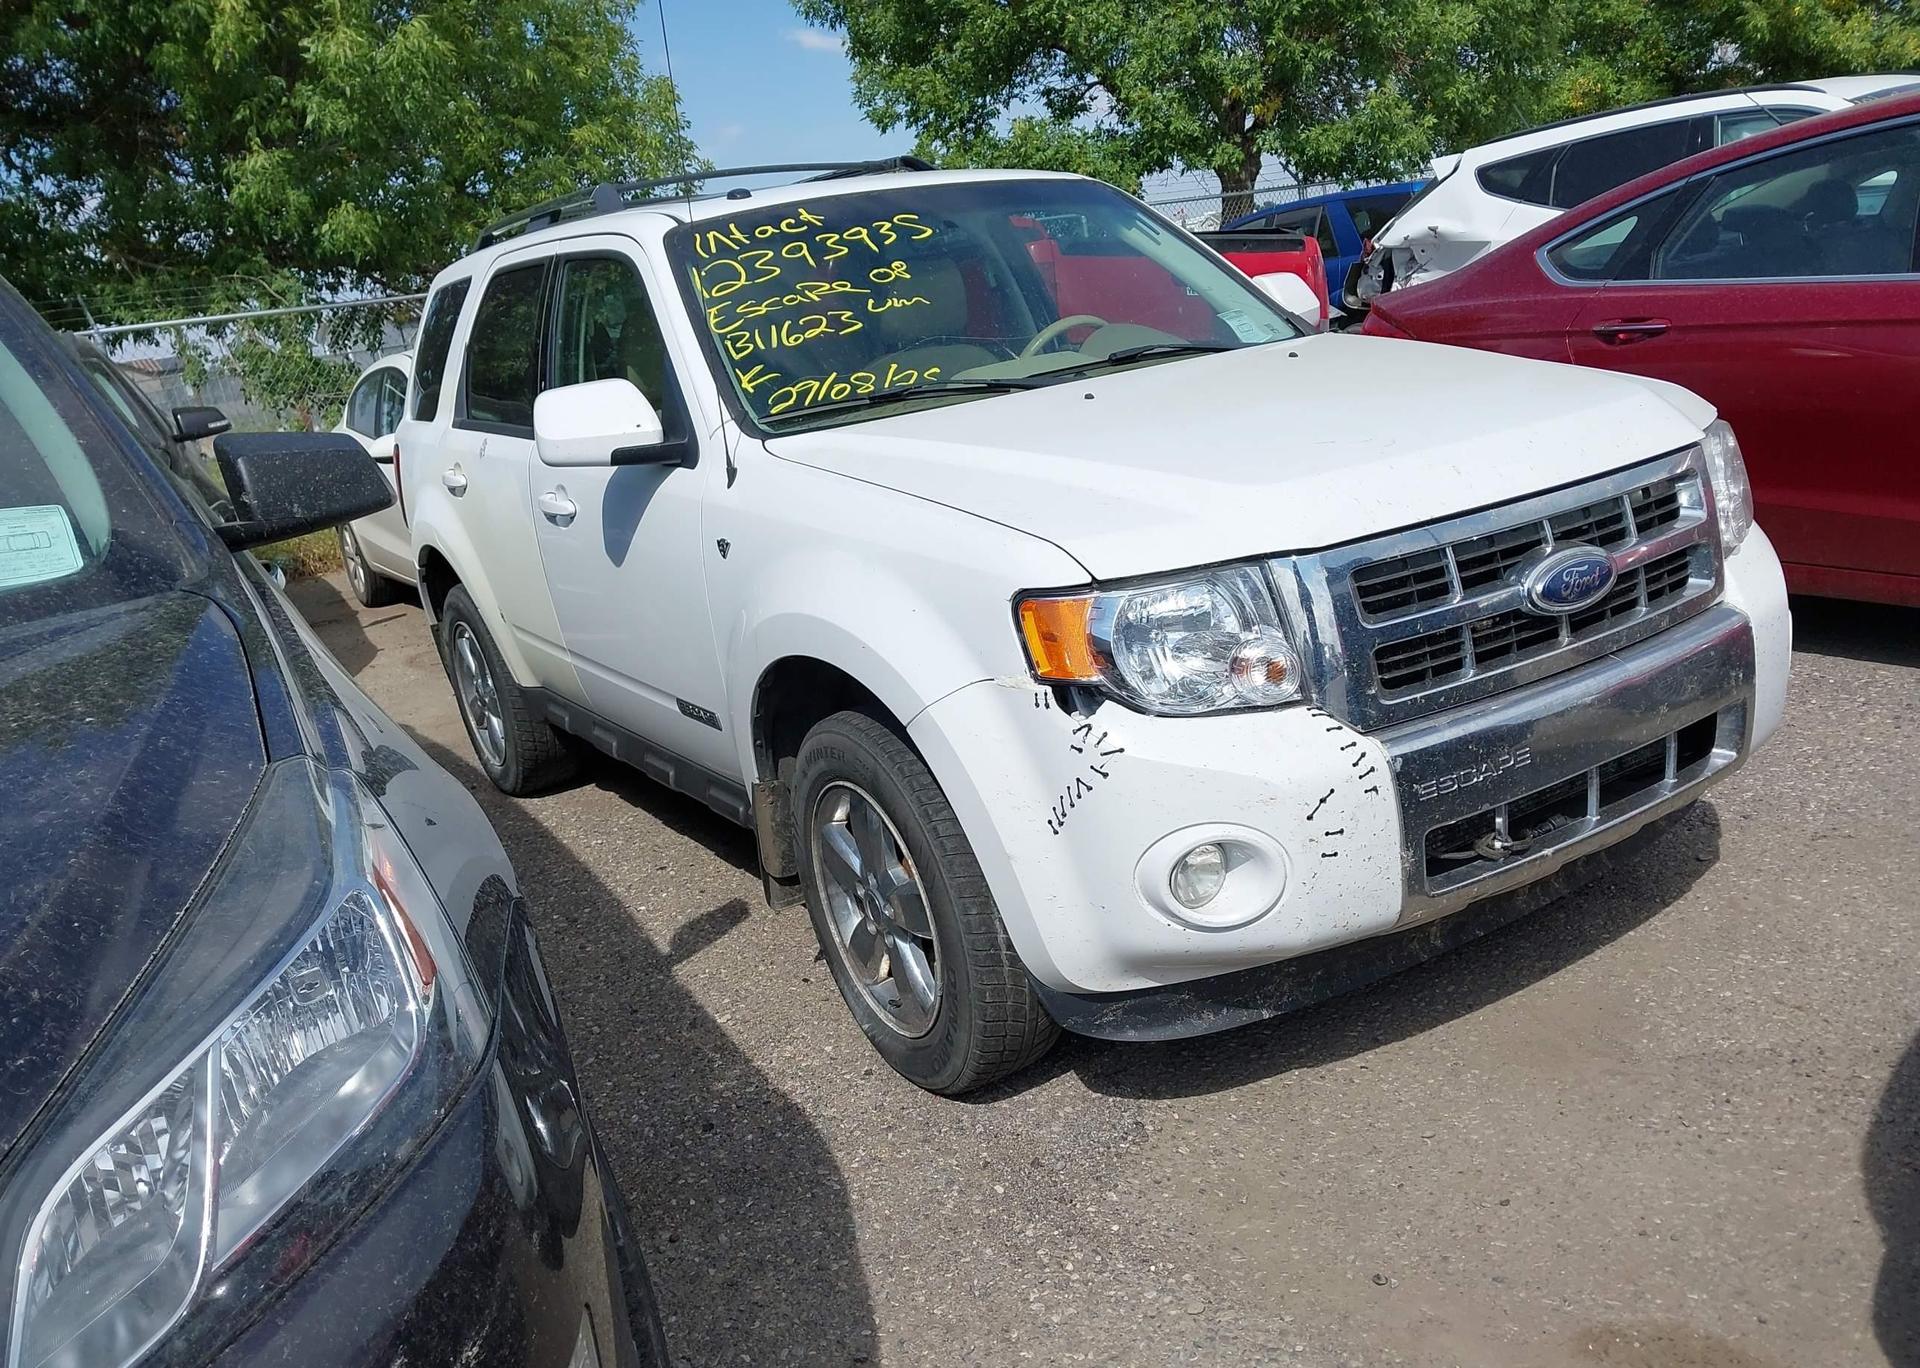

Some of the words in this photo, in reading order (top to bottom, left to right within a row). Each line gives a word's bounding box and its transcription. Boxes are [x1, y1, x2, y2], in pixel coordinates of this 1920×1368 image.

[868, 260, 912, 283] 08
[1561, 564, 1600, 598] Ford
[804, 745, 848, 767] WINTER
[1417, 747, 1532, 801] ESCAPE
